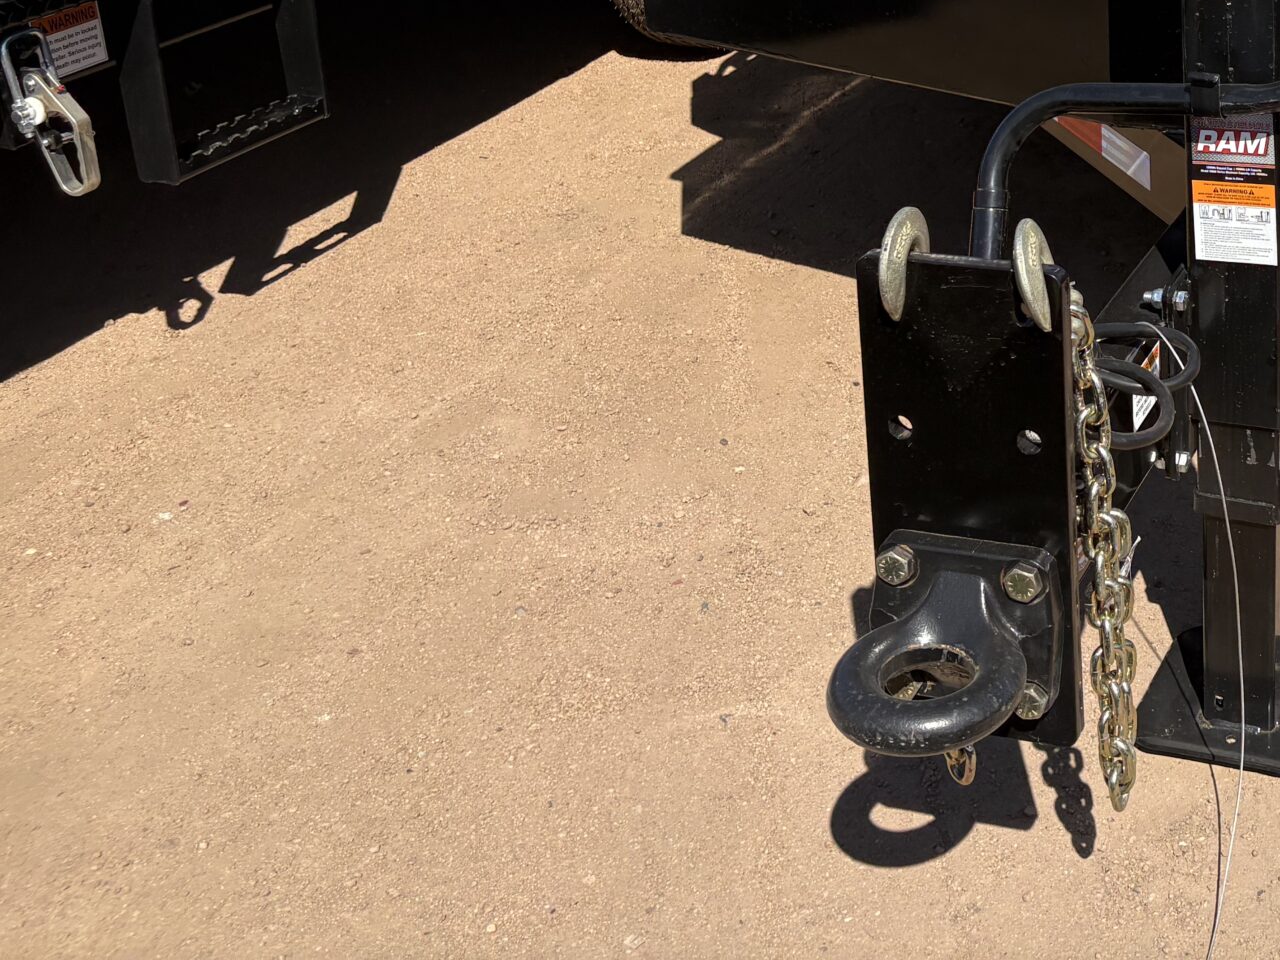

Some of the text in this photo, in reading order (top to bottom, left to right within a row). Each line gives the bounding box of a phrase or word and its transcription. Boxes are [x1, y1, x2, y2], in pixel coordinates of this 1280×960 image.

[48, 5, 96, 32] WARNING
[63, 42, 79, 50] before
[80, 35, 98, 43] moving
[68, 48, 87, 57] Serious
[87, 42, 102, 51] injury
[1197, 129, 1267, 155] RAM
